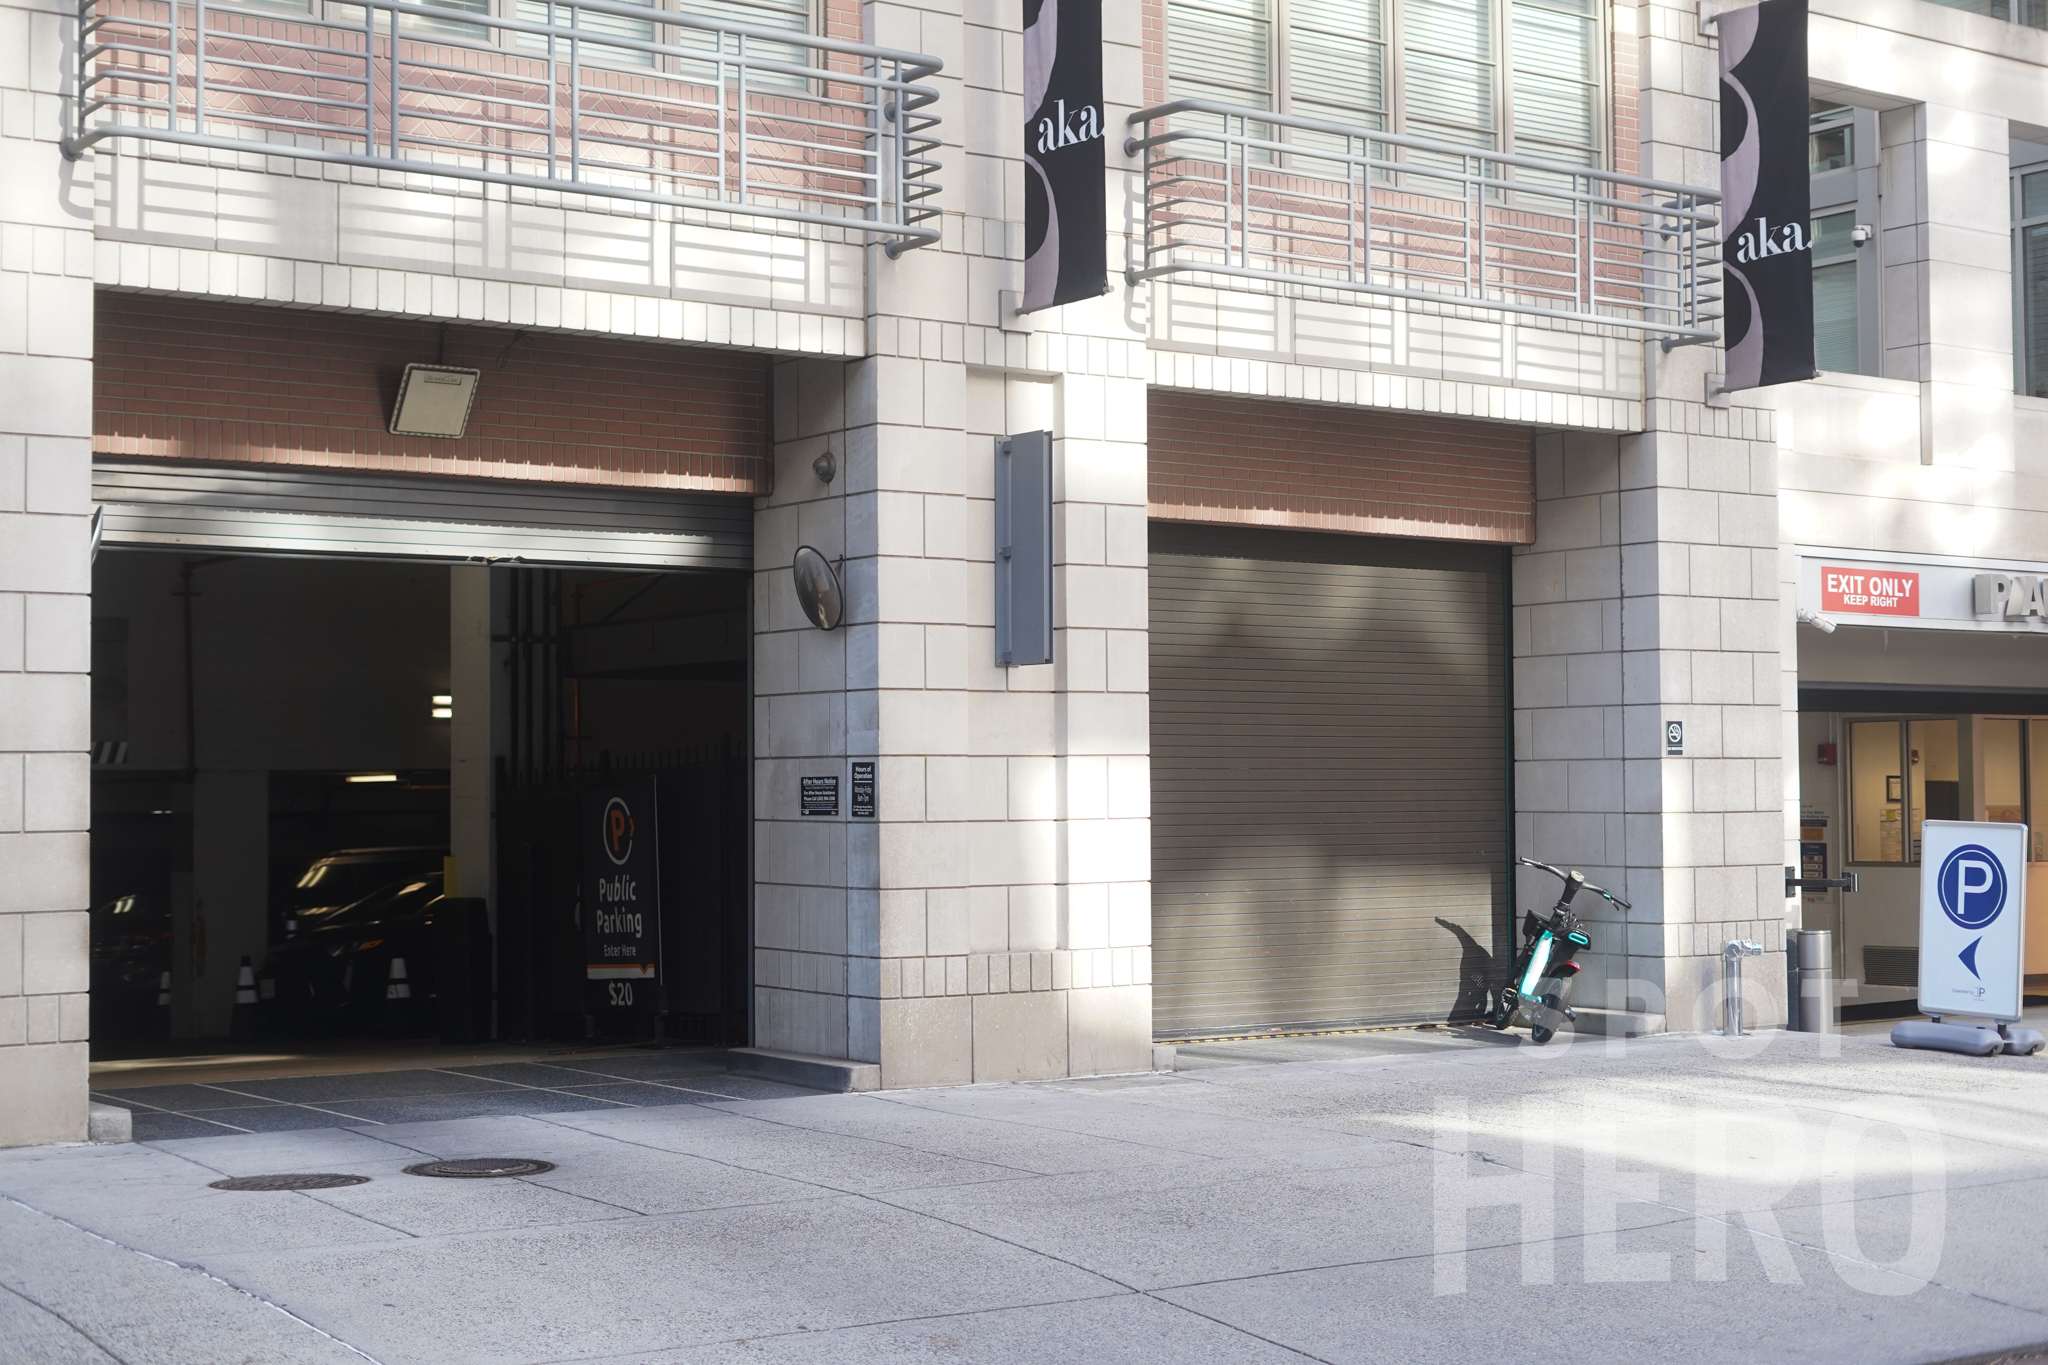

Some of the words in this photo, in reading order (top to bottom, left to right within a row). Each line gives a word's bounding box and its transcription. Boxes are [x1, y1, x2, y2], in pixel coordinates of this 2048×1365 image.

[1827, 573, 1865, 594] EXIT
[1869, 576, 1913, 597] ONLY
[1974, 573, 2048, 617] PA
[1843, 593, 1868, 606] KEEP
[1870, 595, 1898, 608] RIGHT
[599, 874, 637, 902] Public
[1957, 859, 1994, 914] P
[596, 907, 643, 938] Parking
[603, 944, 621, 957] Enter
[621, 944, 636, 957] Here
[608, 980, 633, 1006] $20
